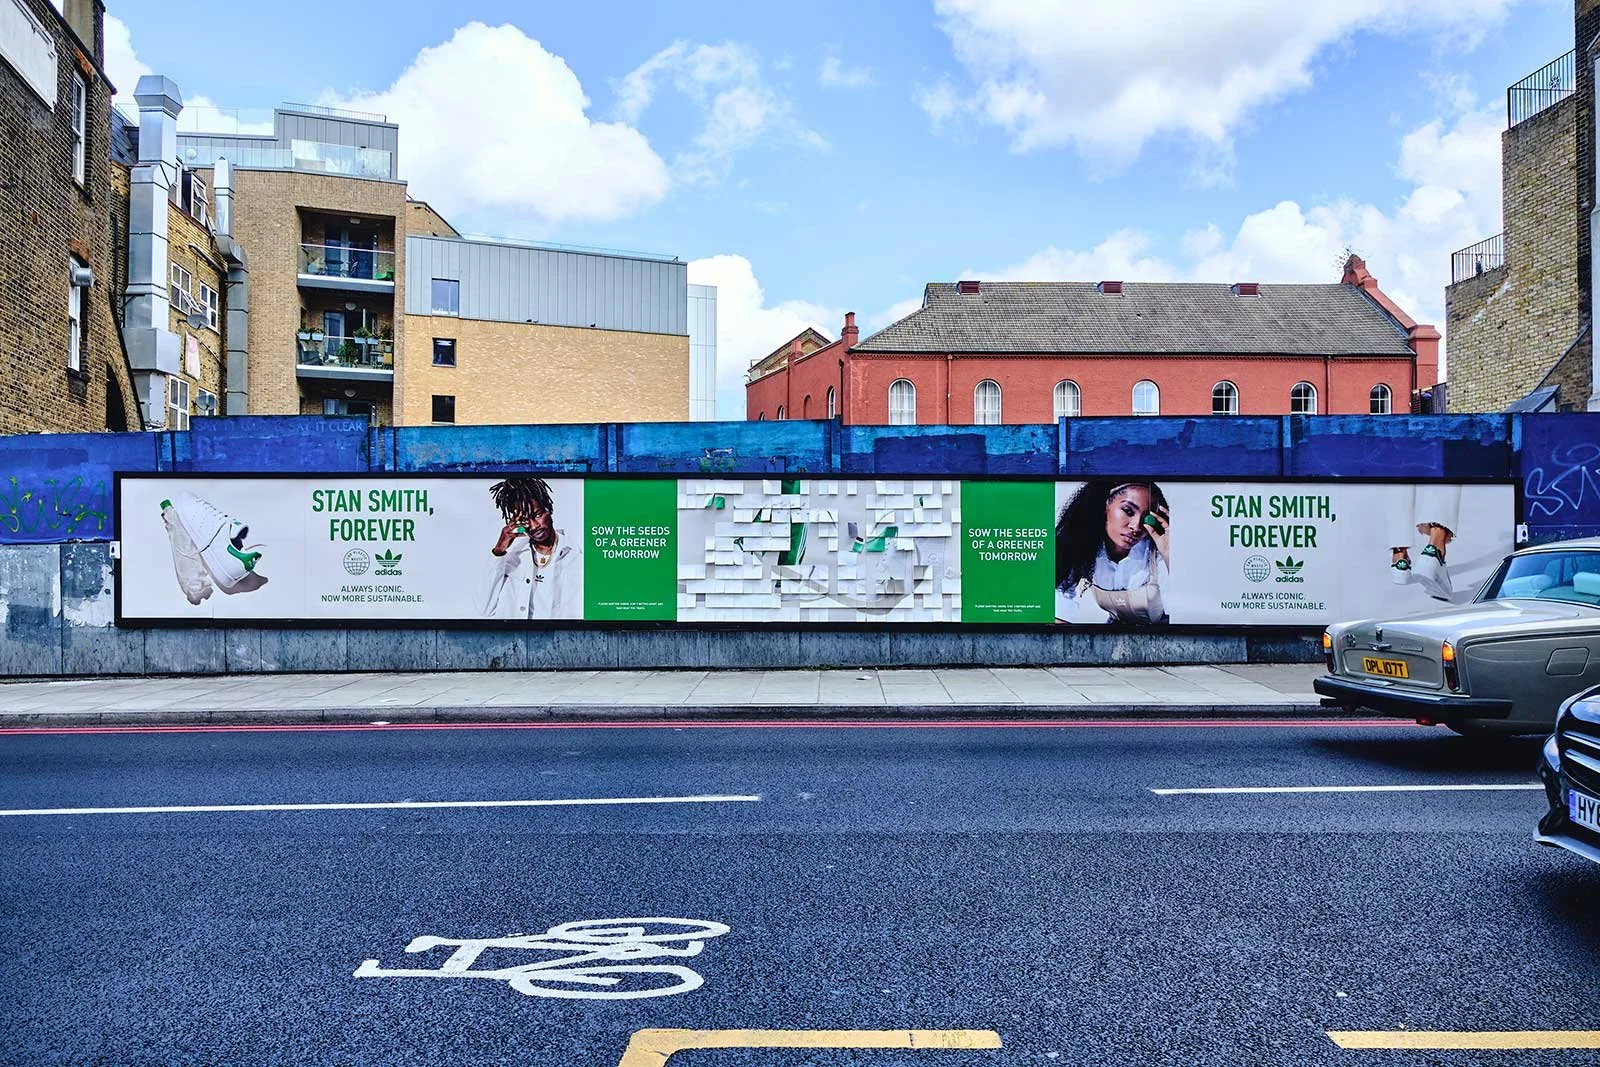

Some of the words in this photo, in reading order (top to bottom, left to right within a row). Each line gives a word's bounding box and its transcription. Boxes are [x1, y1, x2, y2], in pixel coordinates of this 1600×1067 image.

[315, 421, 327, 432] IT
[328, 421, 364, 432] CLEAR
[312, 489, 362, 512] STAN
[368, 489, 434, 516] SMITH,
[1211, 495, 1262, 518] STAN
[1268, 495, 1336, 522] SMITH,
[330, 519, 415, 541] FOREVER
[591, 526, 614, 536] SOW
[616, 526, 636, 536] THE
[638, 526, 670, 536] SEEDS
[968, 528, 991, 538] SOW
[993, 528, 1013, 538] THE
[1015, 528, 1048, 538] SEEDS
[1230, 524, 1317, 548] FOREVER
[595, 538, 609, 547] OF
[610, 538, 618, 547] A
[619, 538, 667, 547] GREENER
[972, 540, 985, 549] OF
[987, 540, 995, 549] A
[996, 540, 1044, 549] GREENER
[602, 549, 660, 559] TOMORROW
[979, 551, 1037, 561] TOMORROW
[374, 568, 403, 576] adidas
[1275, 575, 1304, 583] adidas
[340, 585, 374, 593] ALWAYS
[375, 585, 405, 593] ICONIC.
[1241, 592, 1274, 600] ALWAYS
[1275, 592, 1306, 601] ICONIC.
[1242, 602, 1266, 610] MORE
[1268, 602, 1327, 610] SUSTAINABLE.
